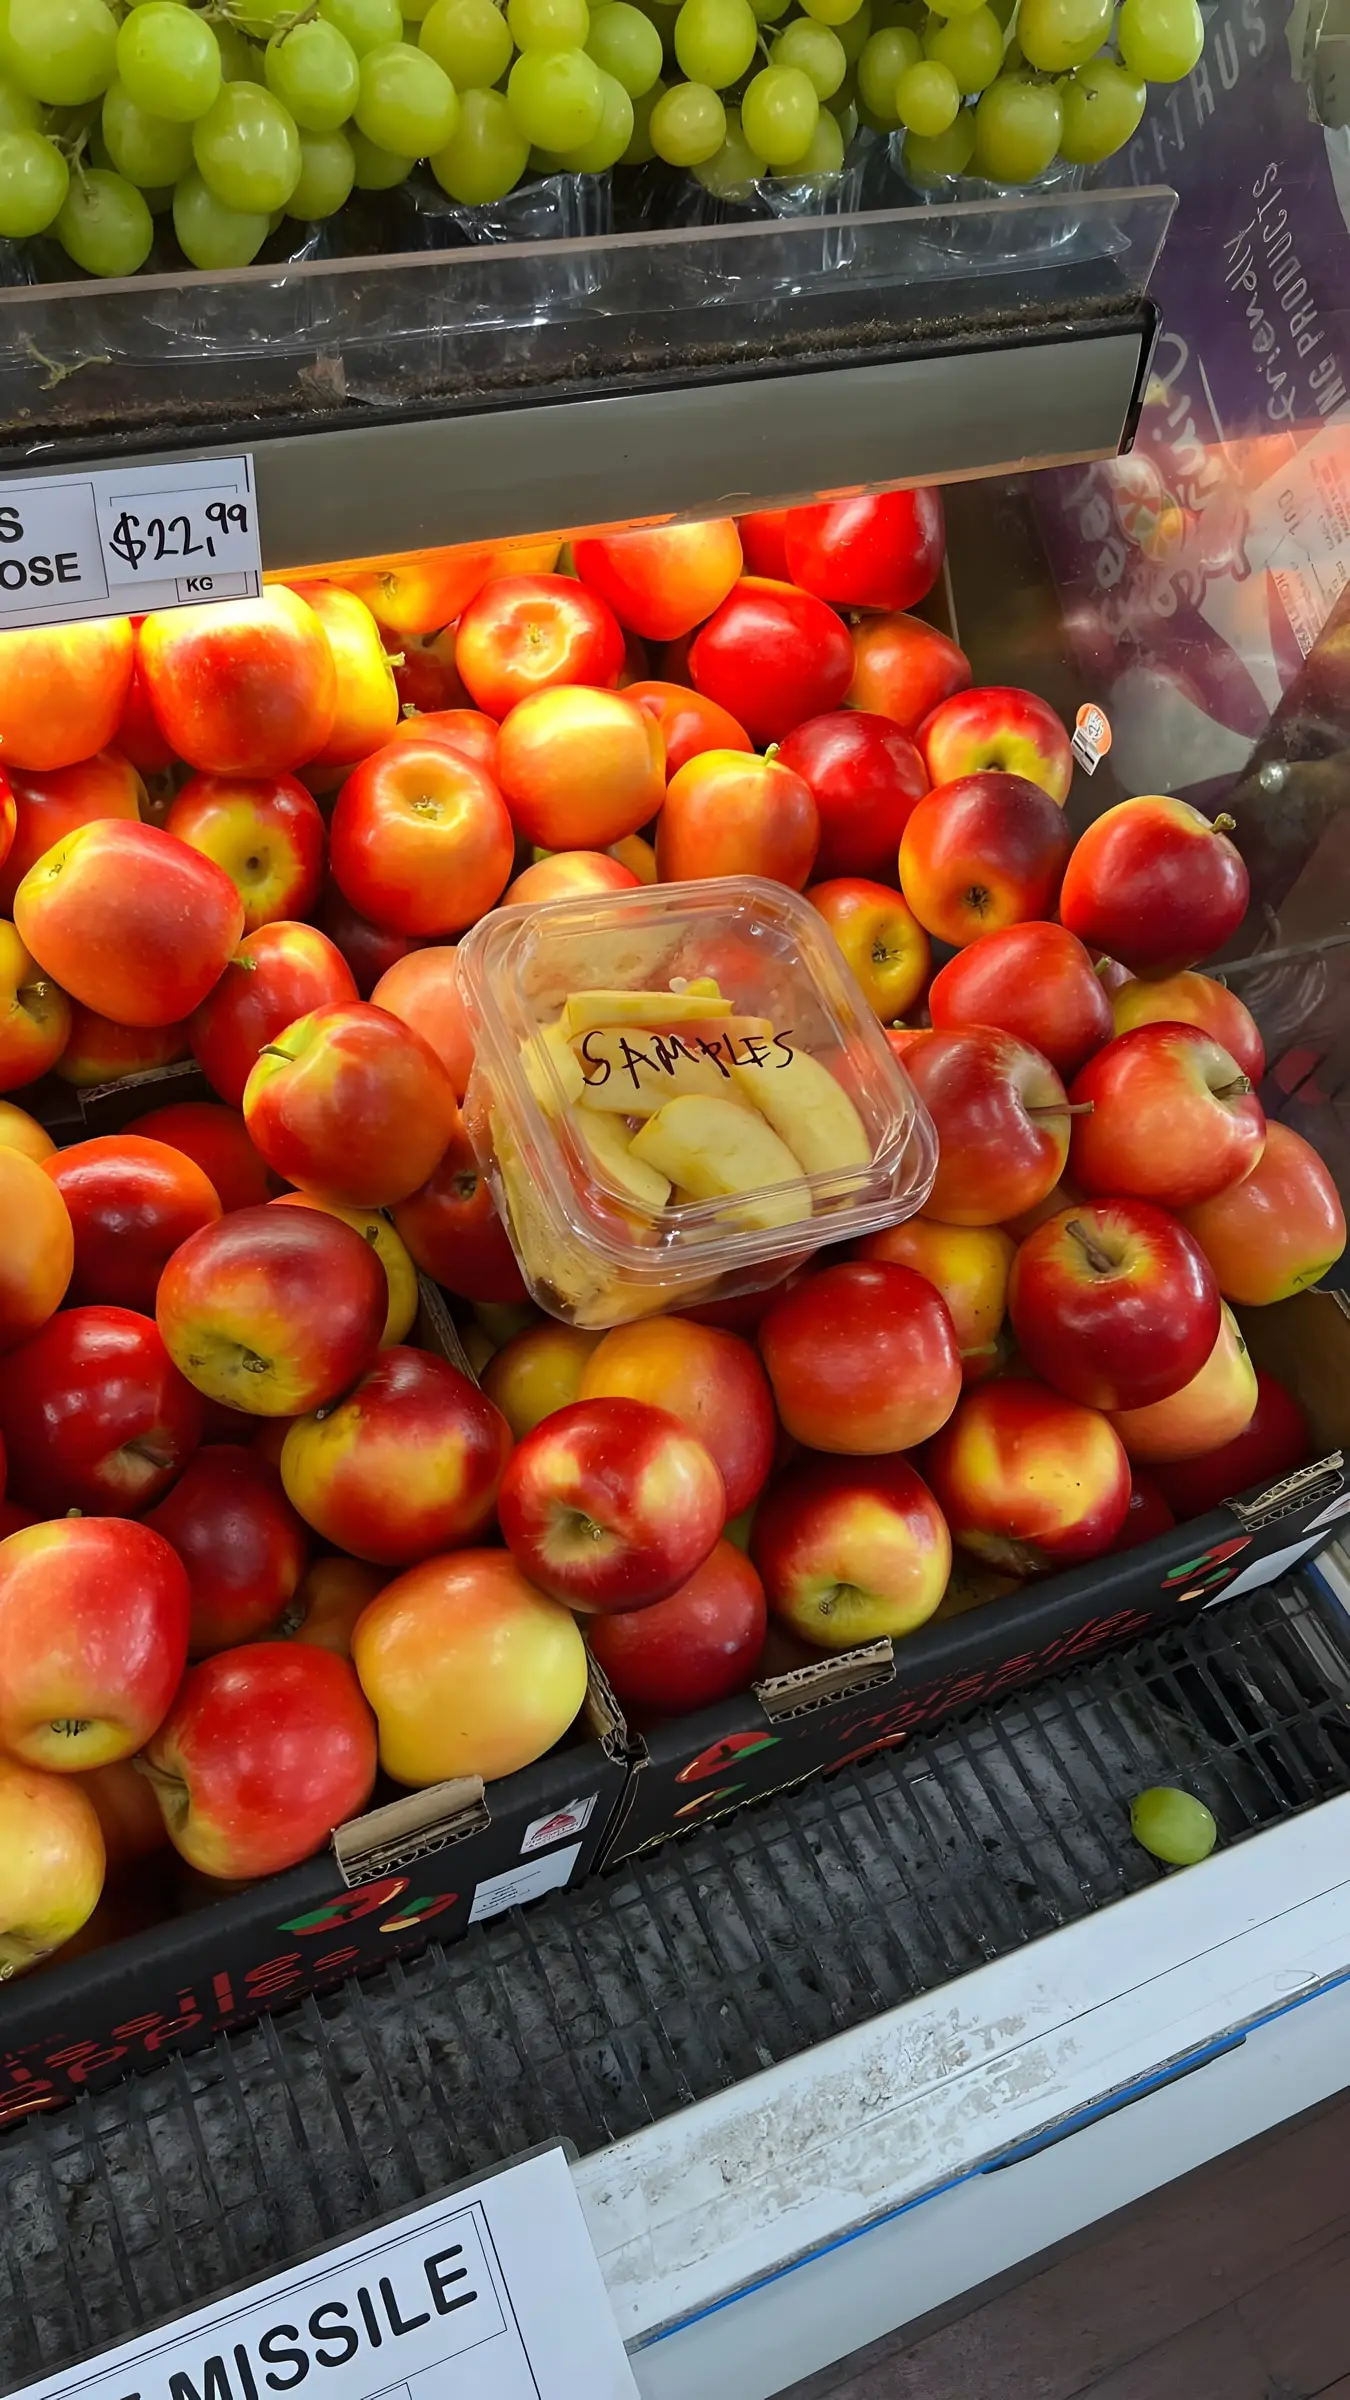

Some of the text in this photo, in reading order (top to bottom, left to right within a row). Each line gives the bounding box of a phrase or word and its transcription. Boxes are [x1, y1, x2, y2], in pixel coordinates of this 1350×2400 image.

[1224, 220, 1297, 424] friendly
[1252, 161, 1326, 358] PRODUCTS
[187, 576, 214, 593] KG
[582, 1030, 794, 1089] SAMPLES
[838, 1608, 1137, 1741] missile
[879, 1611, 1154, 1734] apples
